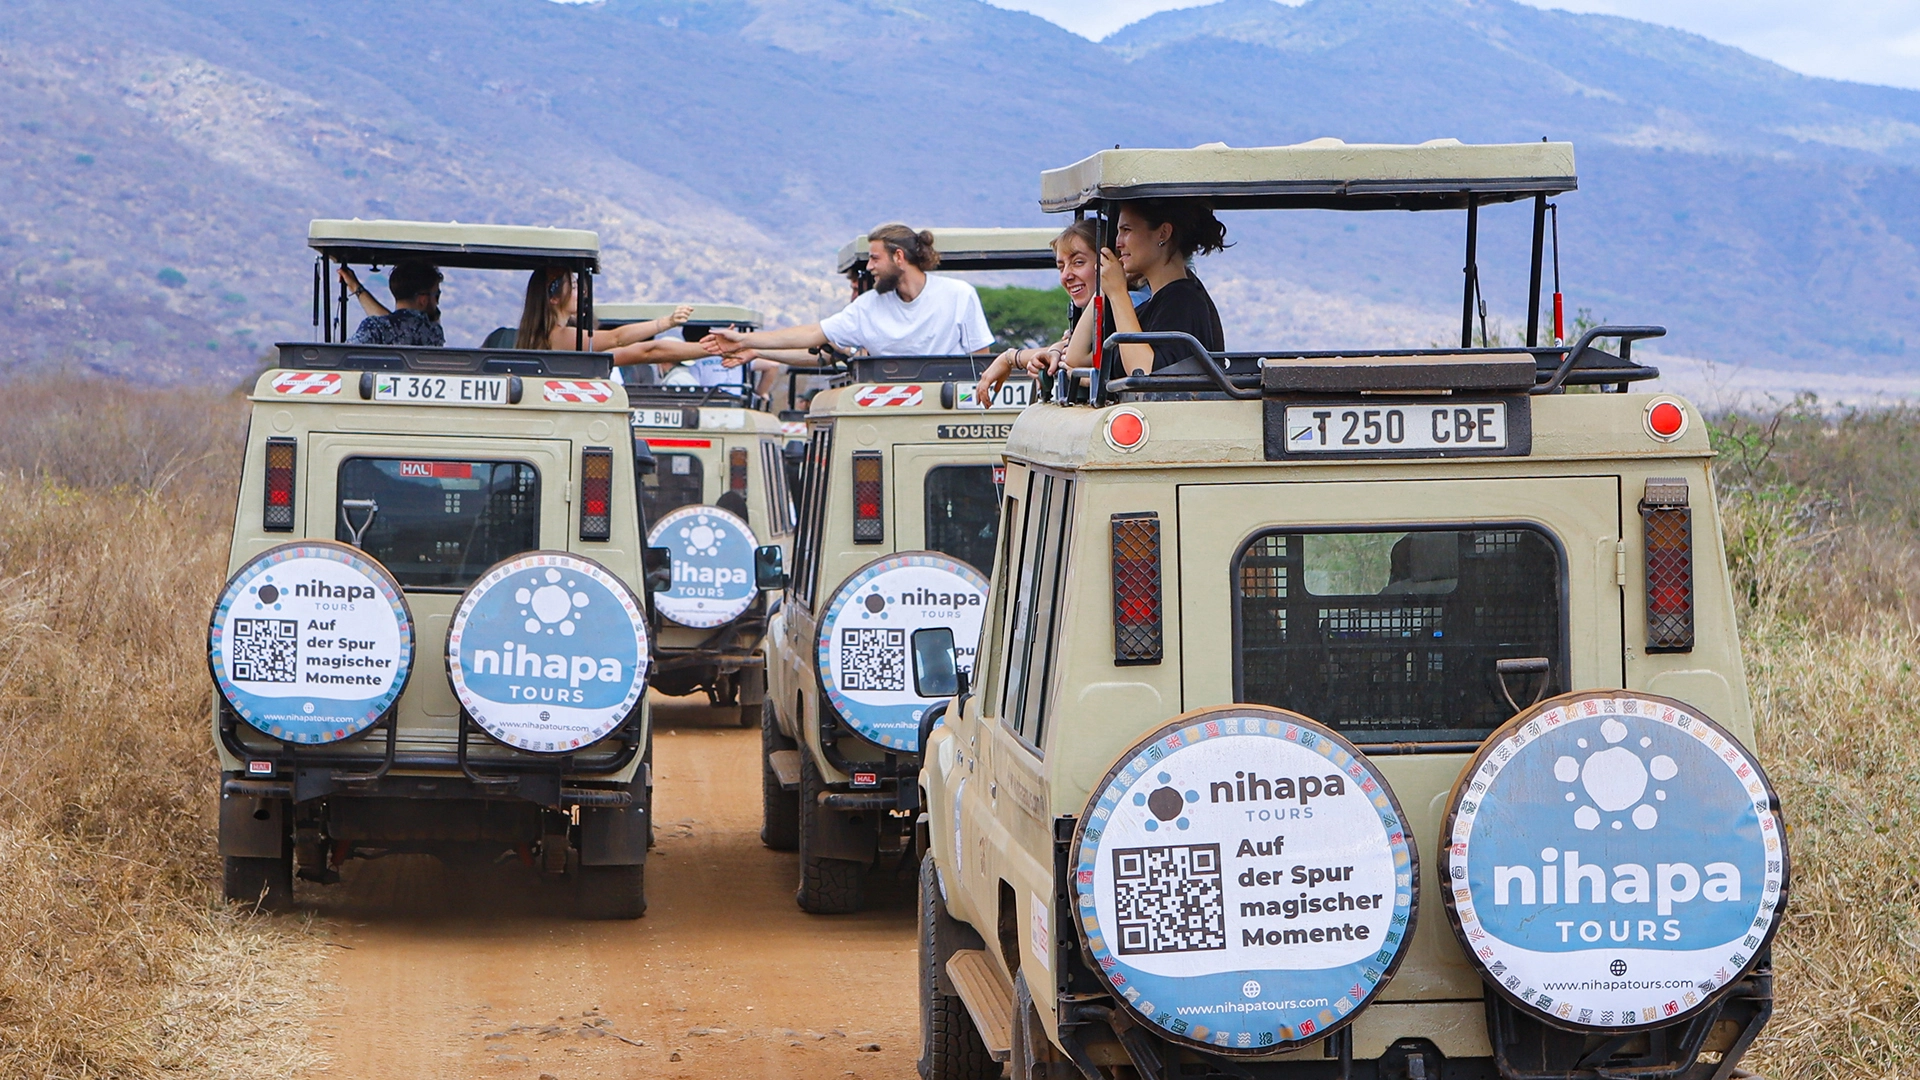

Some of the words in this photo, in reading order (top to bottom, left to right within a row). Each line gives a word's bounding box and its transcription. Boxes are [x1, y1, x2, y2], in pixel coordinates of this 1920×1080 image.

[389, 377, 401, 397] T
[408, 378, 446, 399] 362
[460, 380, 500, 400] EHV
[654, 411, 680, 425] BWU
[1312, 411, 1332, 445] T
[1341, 410, 1405, 445] 250
[1431, 408, 1497, 443] CBE
[945, 425, 1011, 438] TOURIS
[673, 560, 747, 588] ihapa
[295, 579, 376, 602] nihapa
[678, 587, 725, 597] TOURS
[902, 587, 980, 610] nihapa
[315, 603, 355, 611] TOURS
[307, 619, 336, 630] Auf
[306, 636, 334, 649] der
[338, 638, 376, 652] Spur
[306, 654, 392, 669] magischer
[473, 640, 622, 688] nihapa
[306, 672, 382, 685] Momente
[509, 685, 584, 703] TOURS
[263, 713, 354, 723] www.nihapatours.com
[500, 721, 589, 732] www.nihapatours.com
[1210, 770, 1345, 805] nihapa
[1246, 807, 1314, 822] TOURS
[1236, 836, 1285, 858] Auf
[1238, 867, 1283, 887] der
[1291, 865, 1354, 889] Spur
[1493, 846, 1741, 916] nihapa
[1240, 891, 1383, 921] magischer
[1242, 923, 1370, 947] Momente
[1556, 920, 1681, 943] TOURS
[1543, 979, 1694, 992] www.nihapatours.com
[1176, 996, 1329, 1015] www.nihapatours.com
